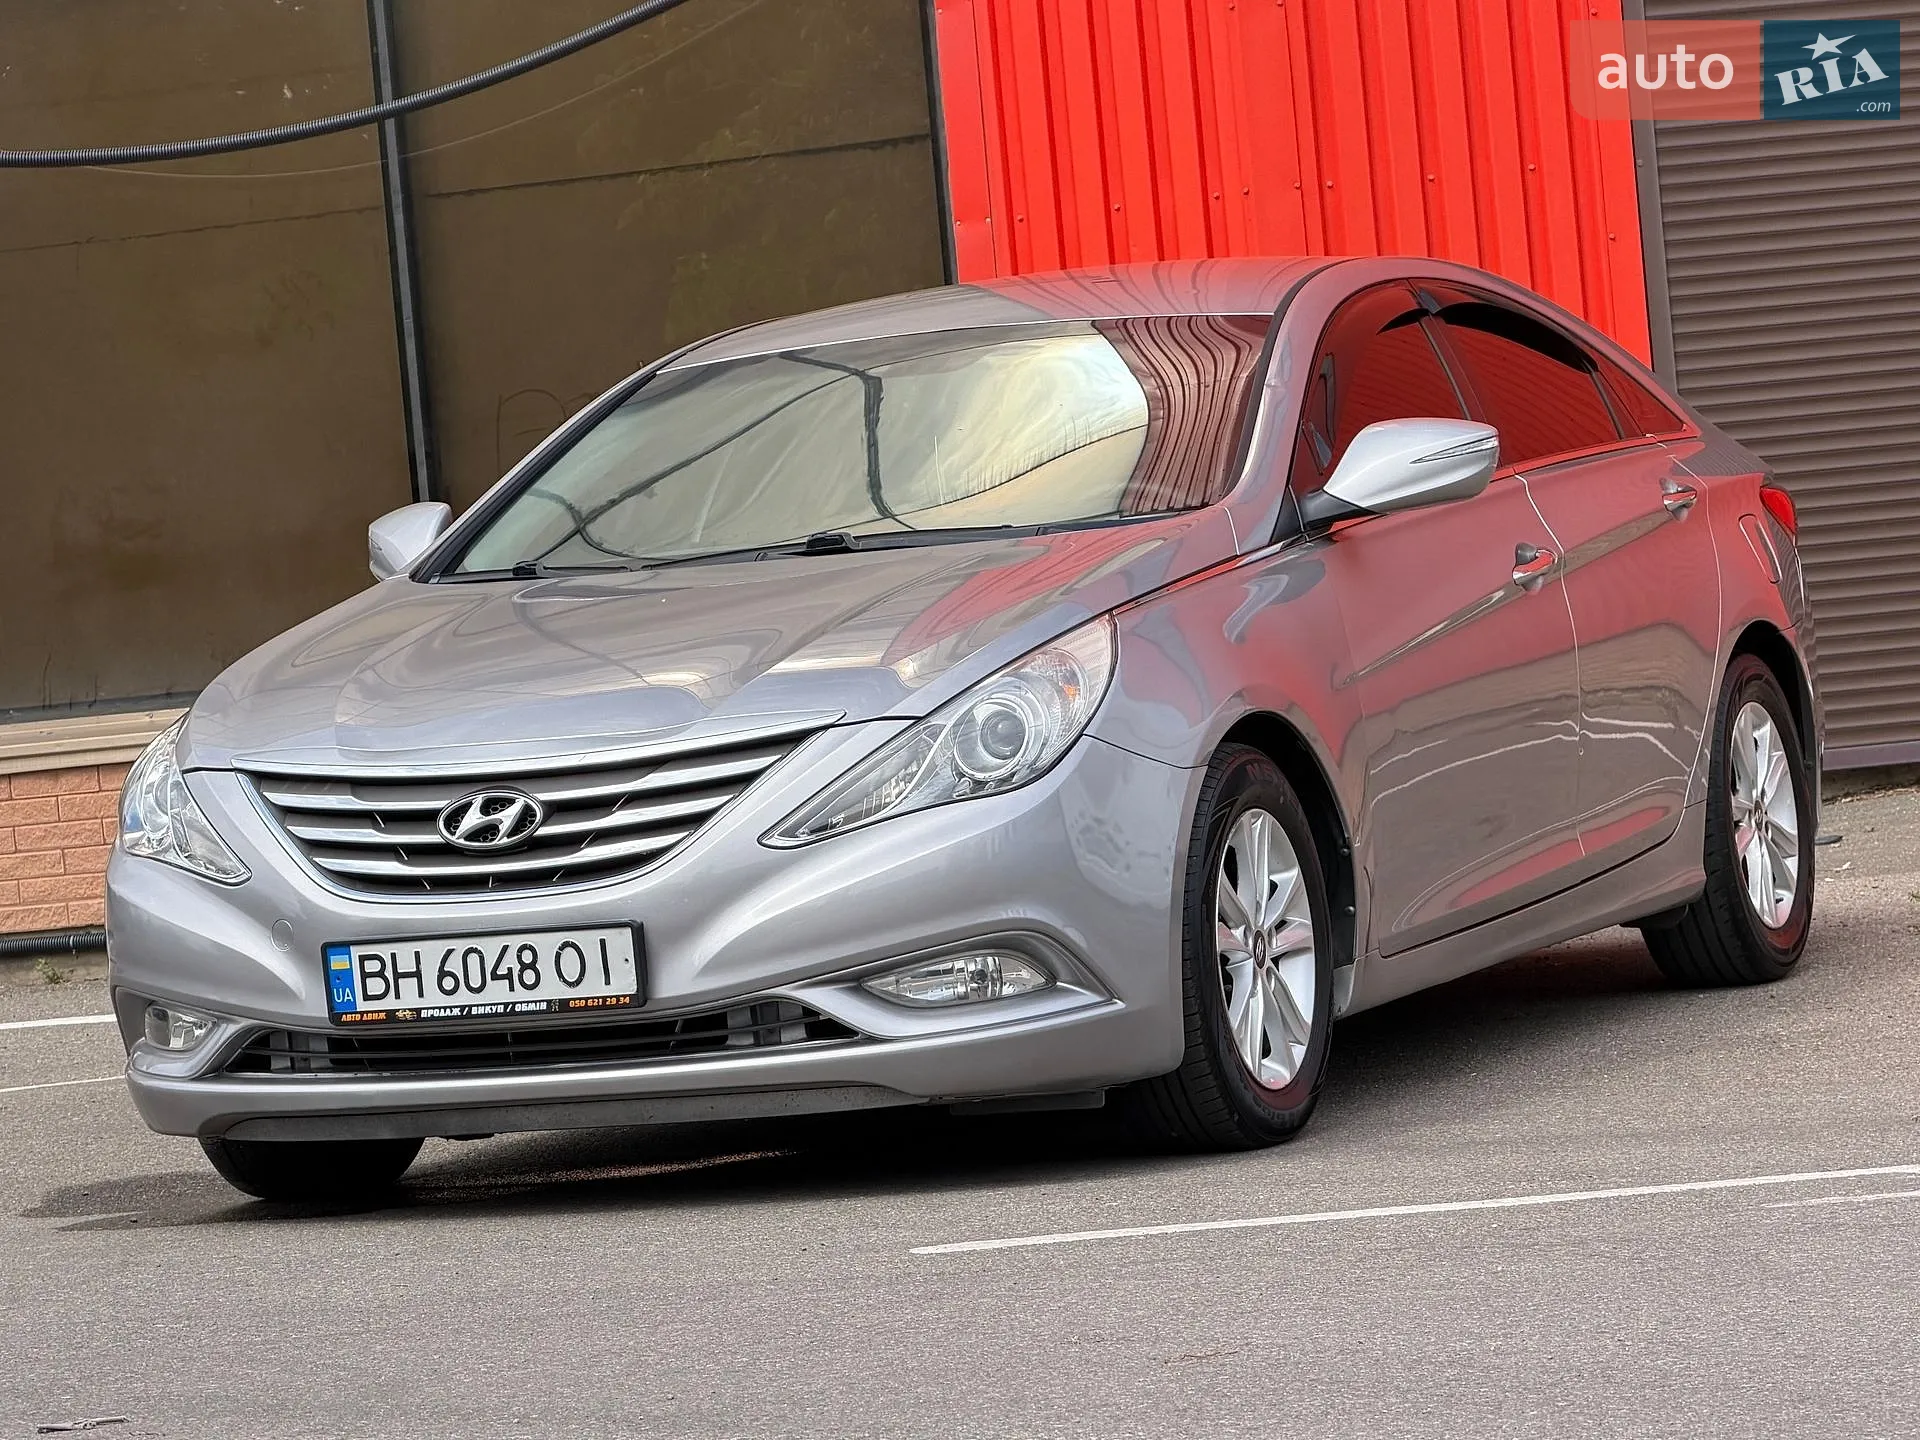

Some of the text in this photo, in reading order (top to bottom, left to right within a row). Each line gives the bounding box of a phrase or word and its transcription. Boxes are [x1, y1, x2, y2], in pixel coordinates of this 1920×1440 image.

[358, 950, 424, 1001] BH
[436, 943, 541, 996] 6048
[334, 988, 354, 1003] UA
[569, 999, 586, 1008] 050
[587, 998, 603, 1007] 621
[618, 996, 630, 1004] 34
[420, 1007, 461, 1018] ПРОДАЖ
[471, 1003, 504, 1015] ВИКУП
[514, 1001, 547, 1012] ОБМІН
